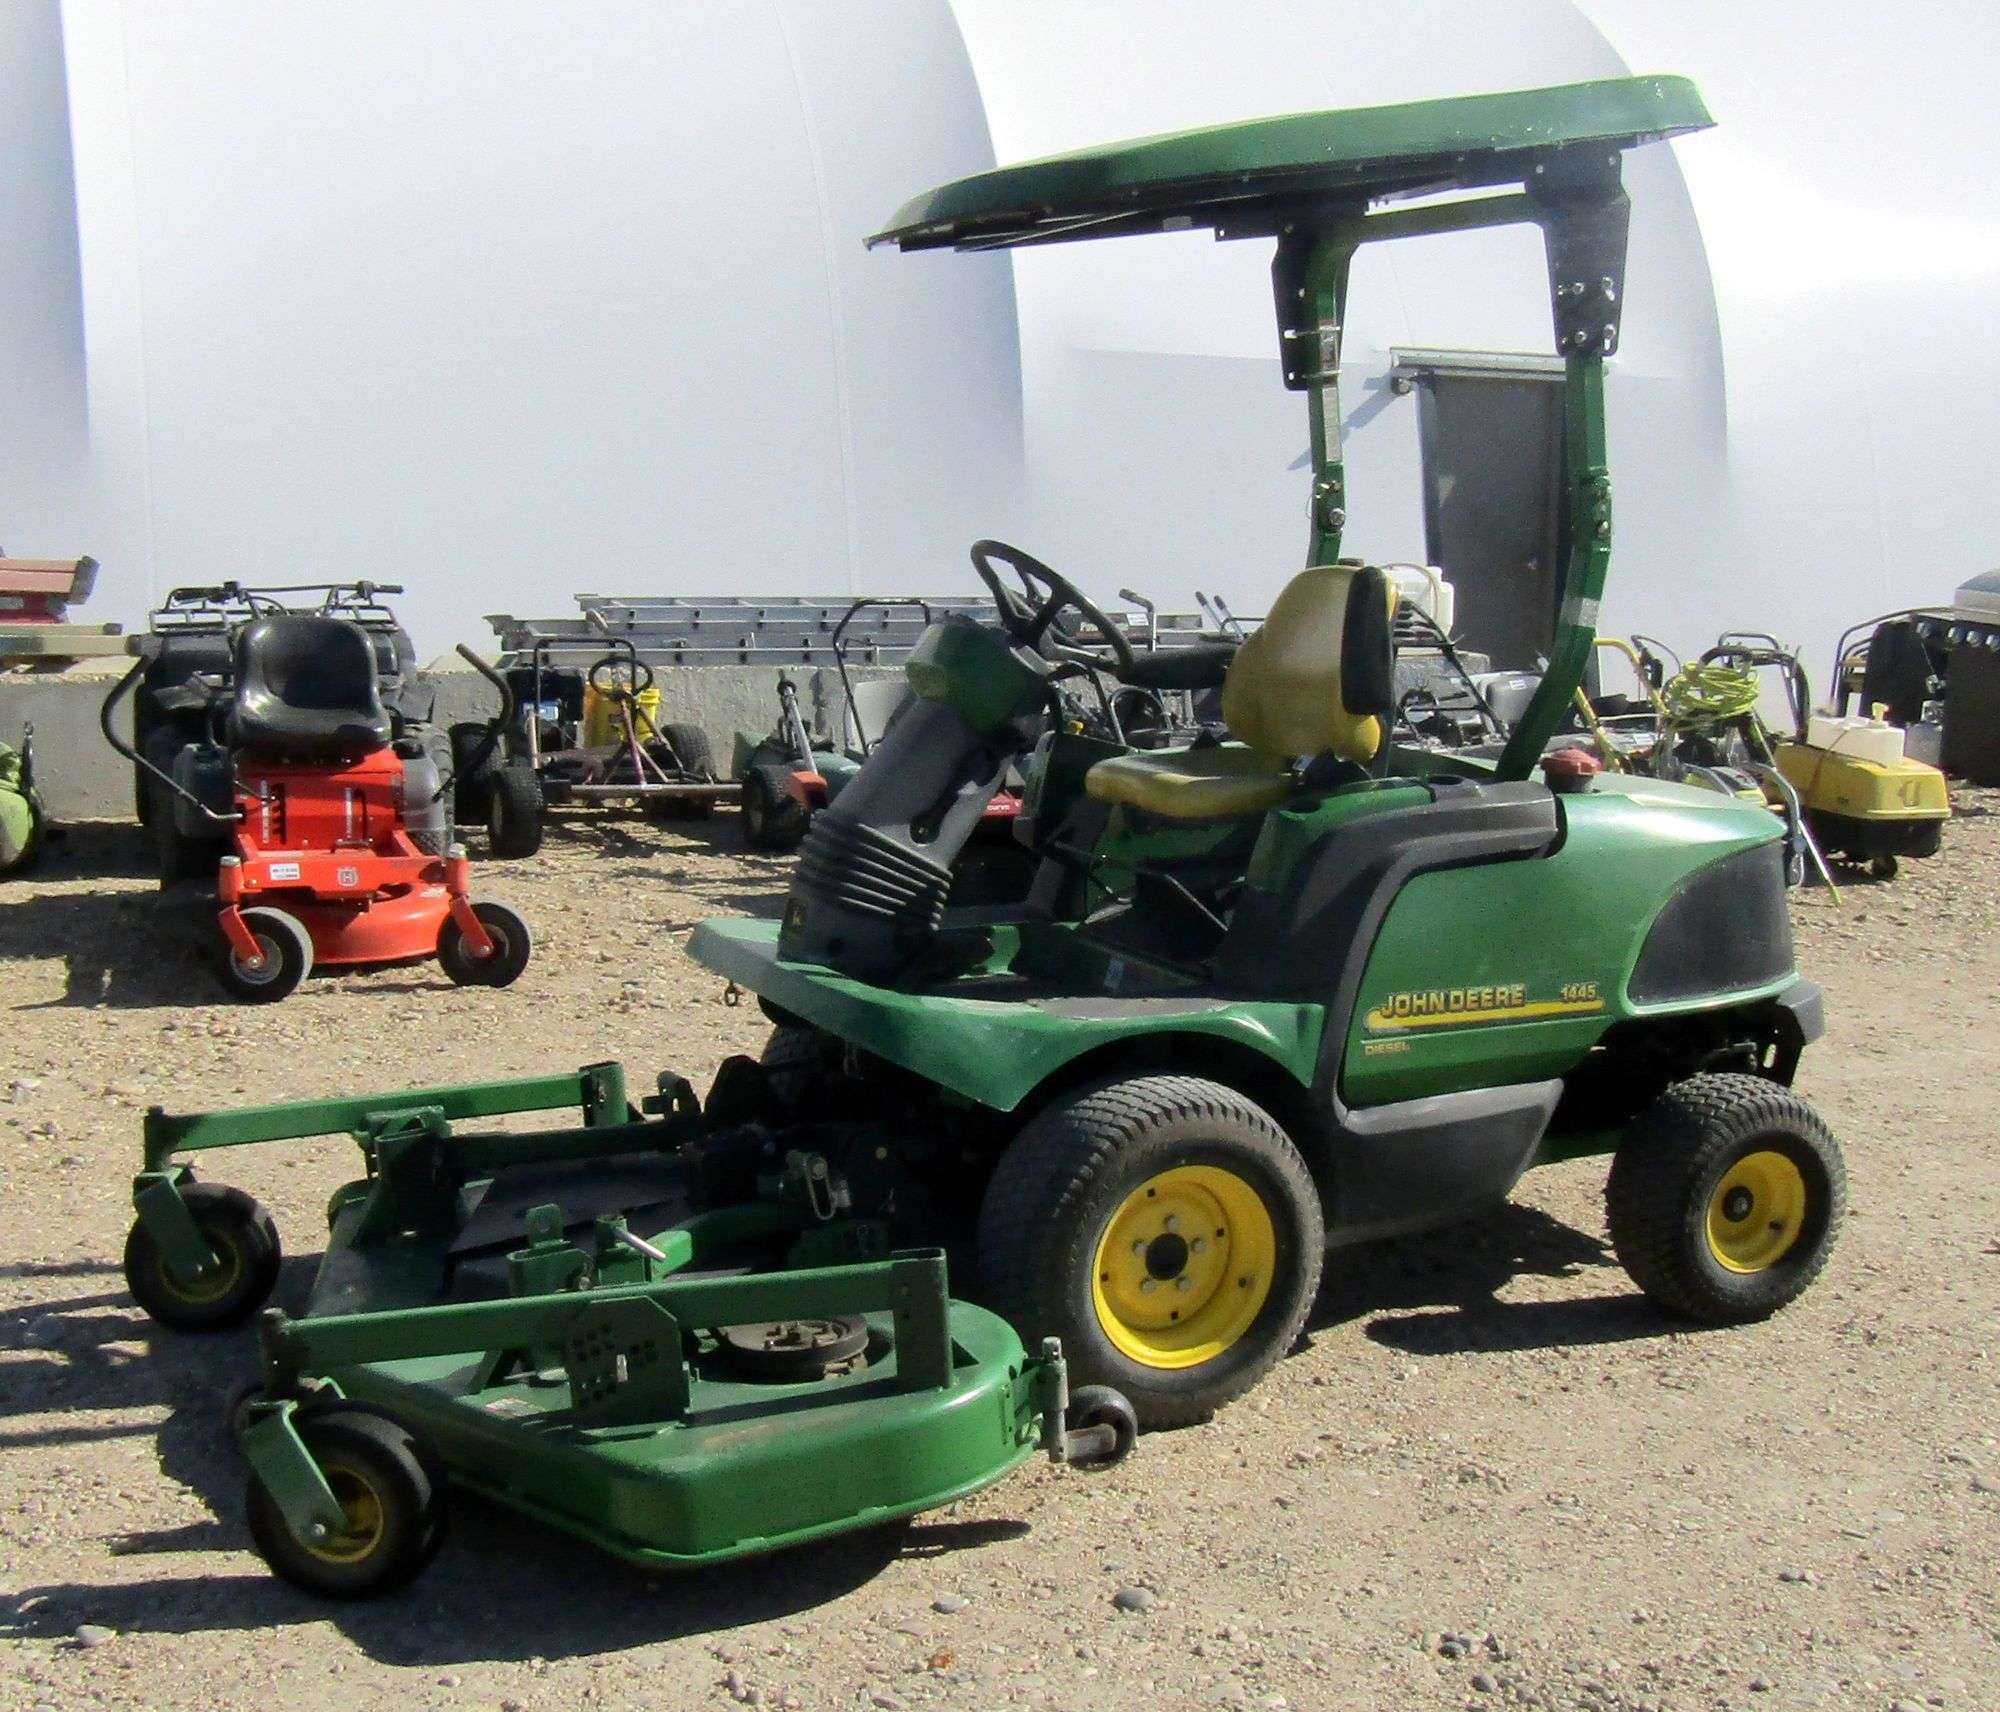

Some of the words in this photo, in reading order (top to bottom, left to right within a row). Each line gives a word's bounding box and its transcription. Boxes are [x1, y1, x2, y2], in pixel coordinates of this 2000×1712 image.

[1381, 991, 1446, 1018] JOHN
[1449, 984, 1526, 1012] DEERE
[1560, 983, 1597, 1000] 1445
